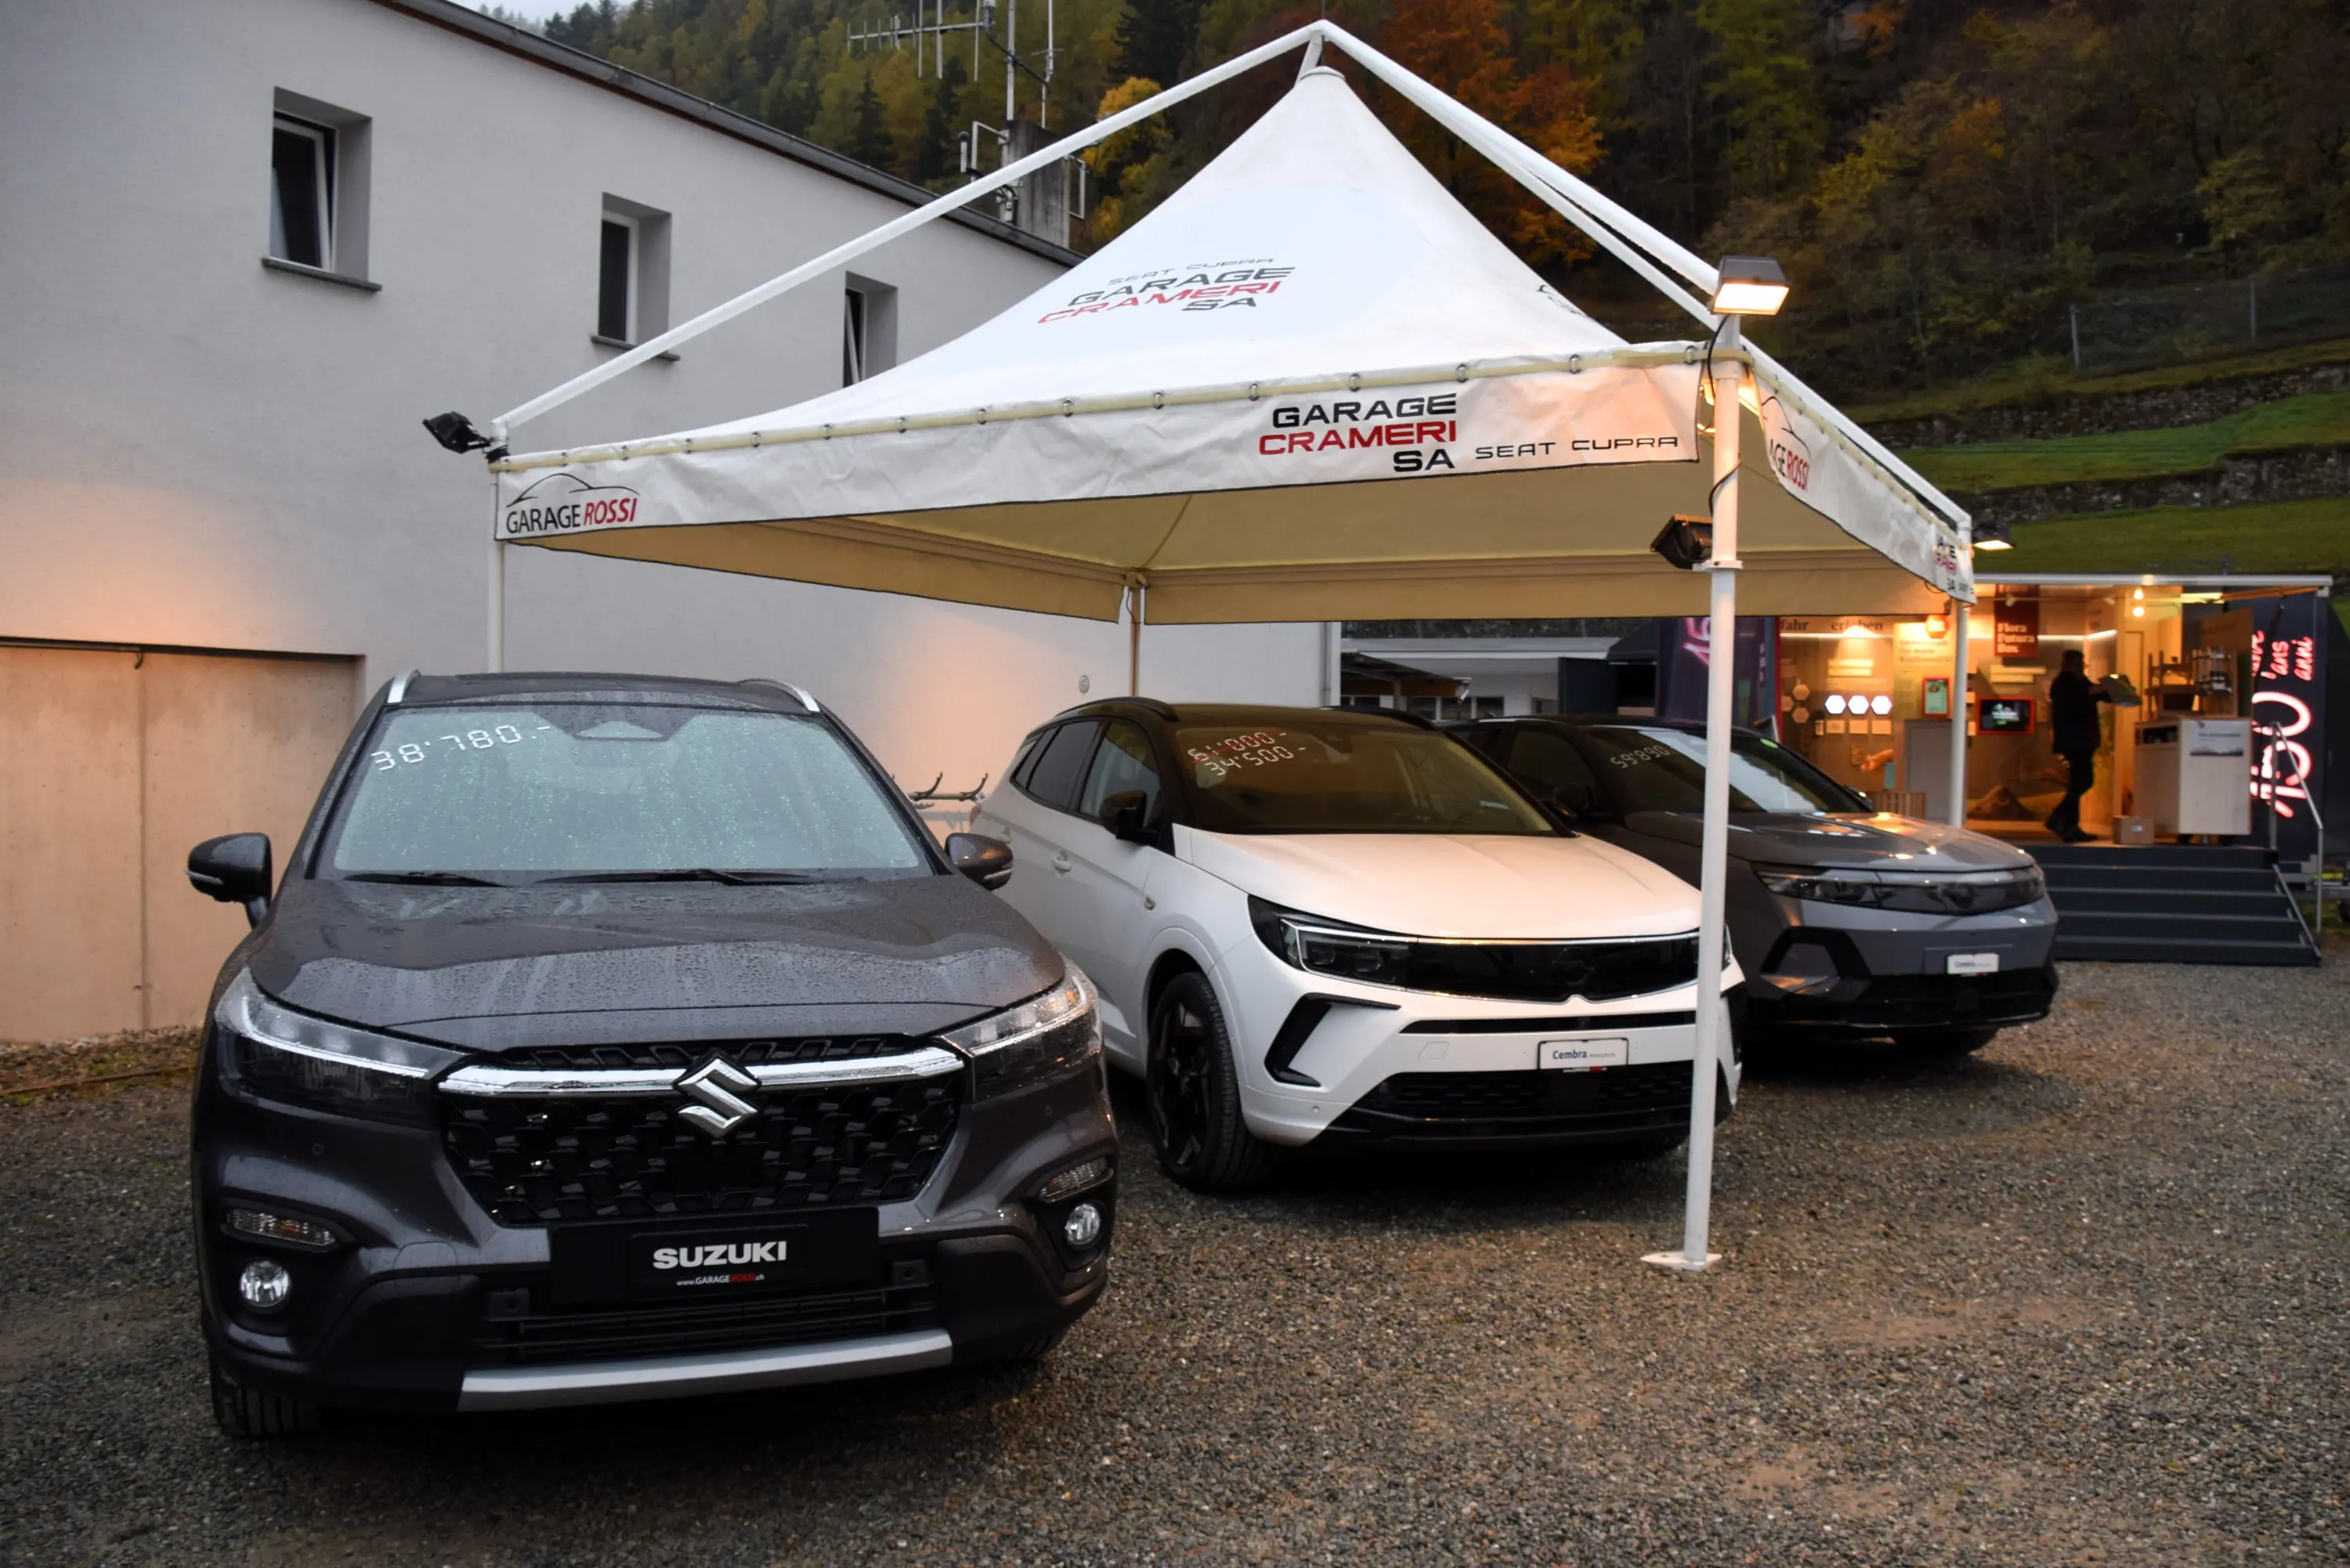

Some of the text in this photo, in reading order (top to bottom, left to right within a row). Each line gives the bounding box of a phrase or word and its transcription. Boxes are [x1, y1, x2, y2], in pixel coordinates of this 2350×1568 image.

[1068, 266, 1296, 307] GARAGE
[1108, 258, 1274, 285] SEAT CUPRA
[1038, 280, 1282, 324] CRAMERI
[1181, 297, 1257, 312] SA
[1272, 392, 1457, 428] GARAGE
[1259, 420, 1457, 456] CRAMERI
[1393, 435, 1679, 472] SA SEAT CUPRA
[506, 498, 638, 534] GARAGE ROSSI
[1552, 1049, 1589, 1060] Cembra
[653, 1240, 787, 1270] SUZUKI
[676, 1273, 765, 1286] www.GARAGE.ch
